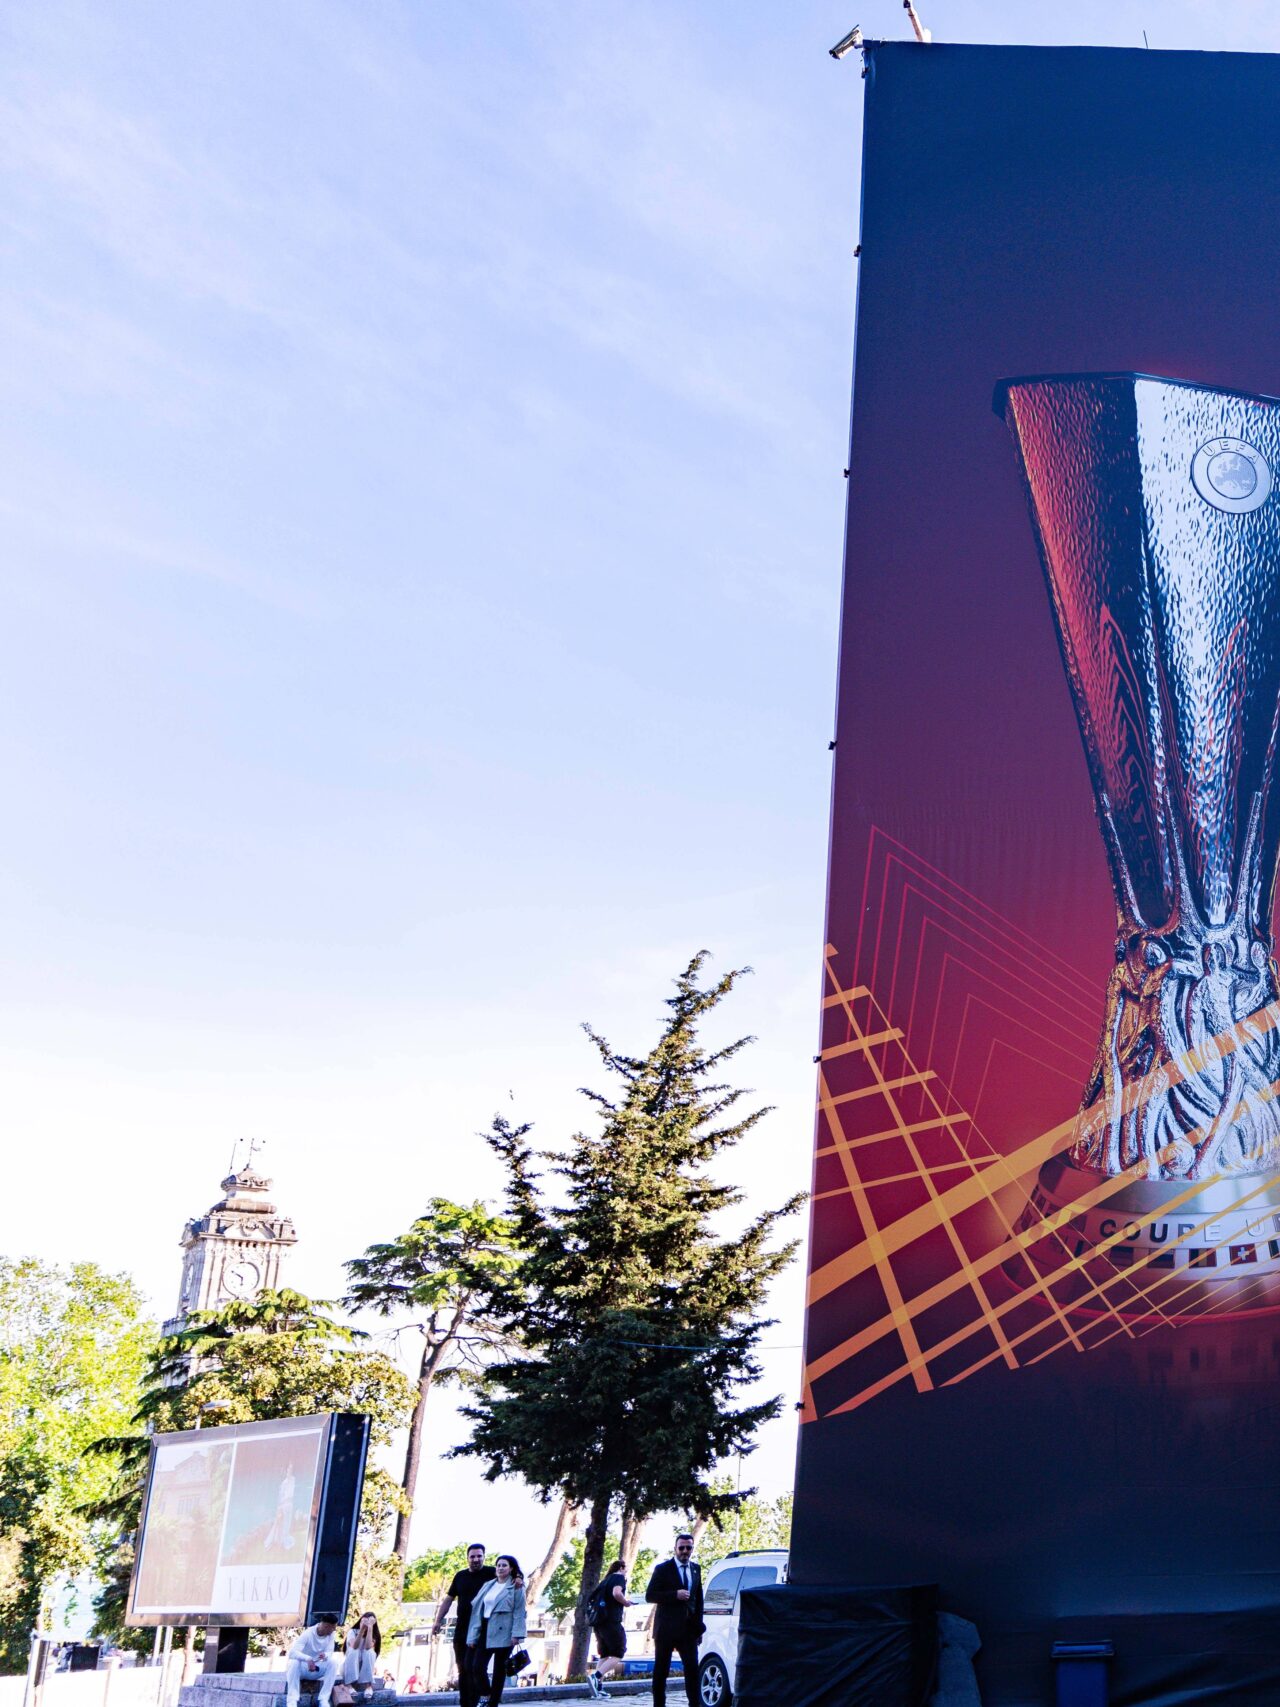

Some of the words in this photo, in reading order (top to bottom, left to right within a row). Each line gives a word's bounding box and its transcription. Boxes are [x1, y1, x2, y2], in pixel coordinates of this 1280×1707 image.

[1202, 440, 1259, 464] UEFA
[1100, 1219, 1222, 1243] COUPE
[228, 1575, 289, 1602] VAKKO
